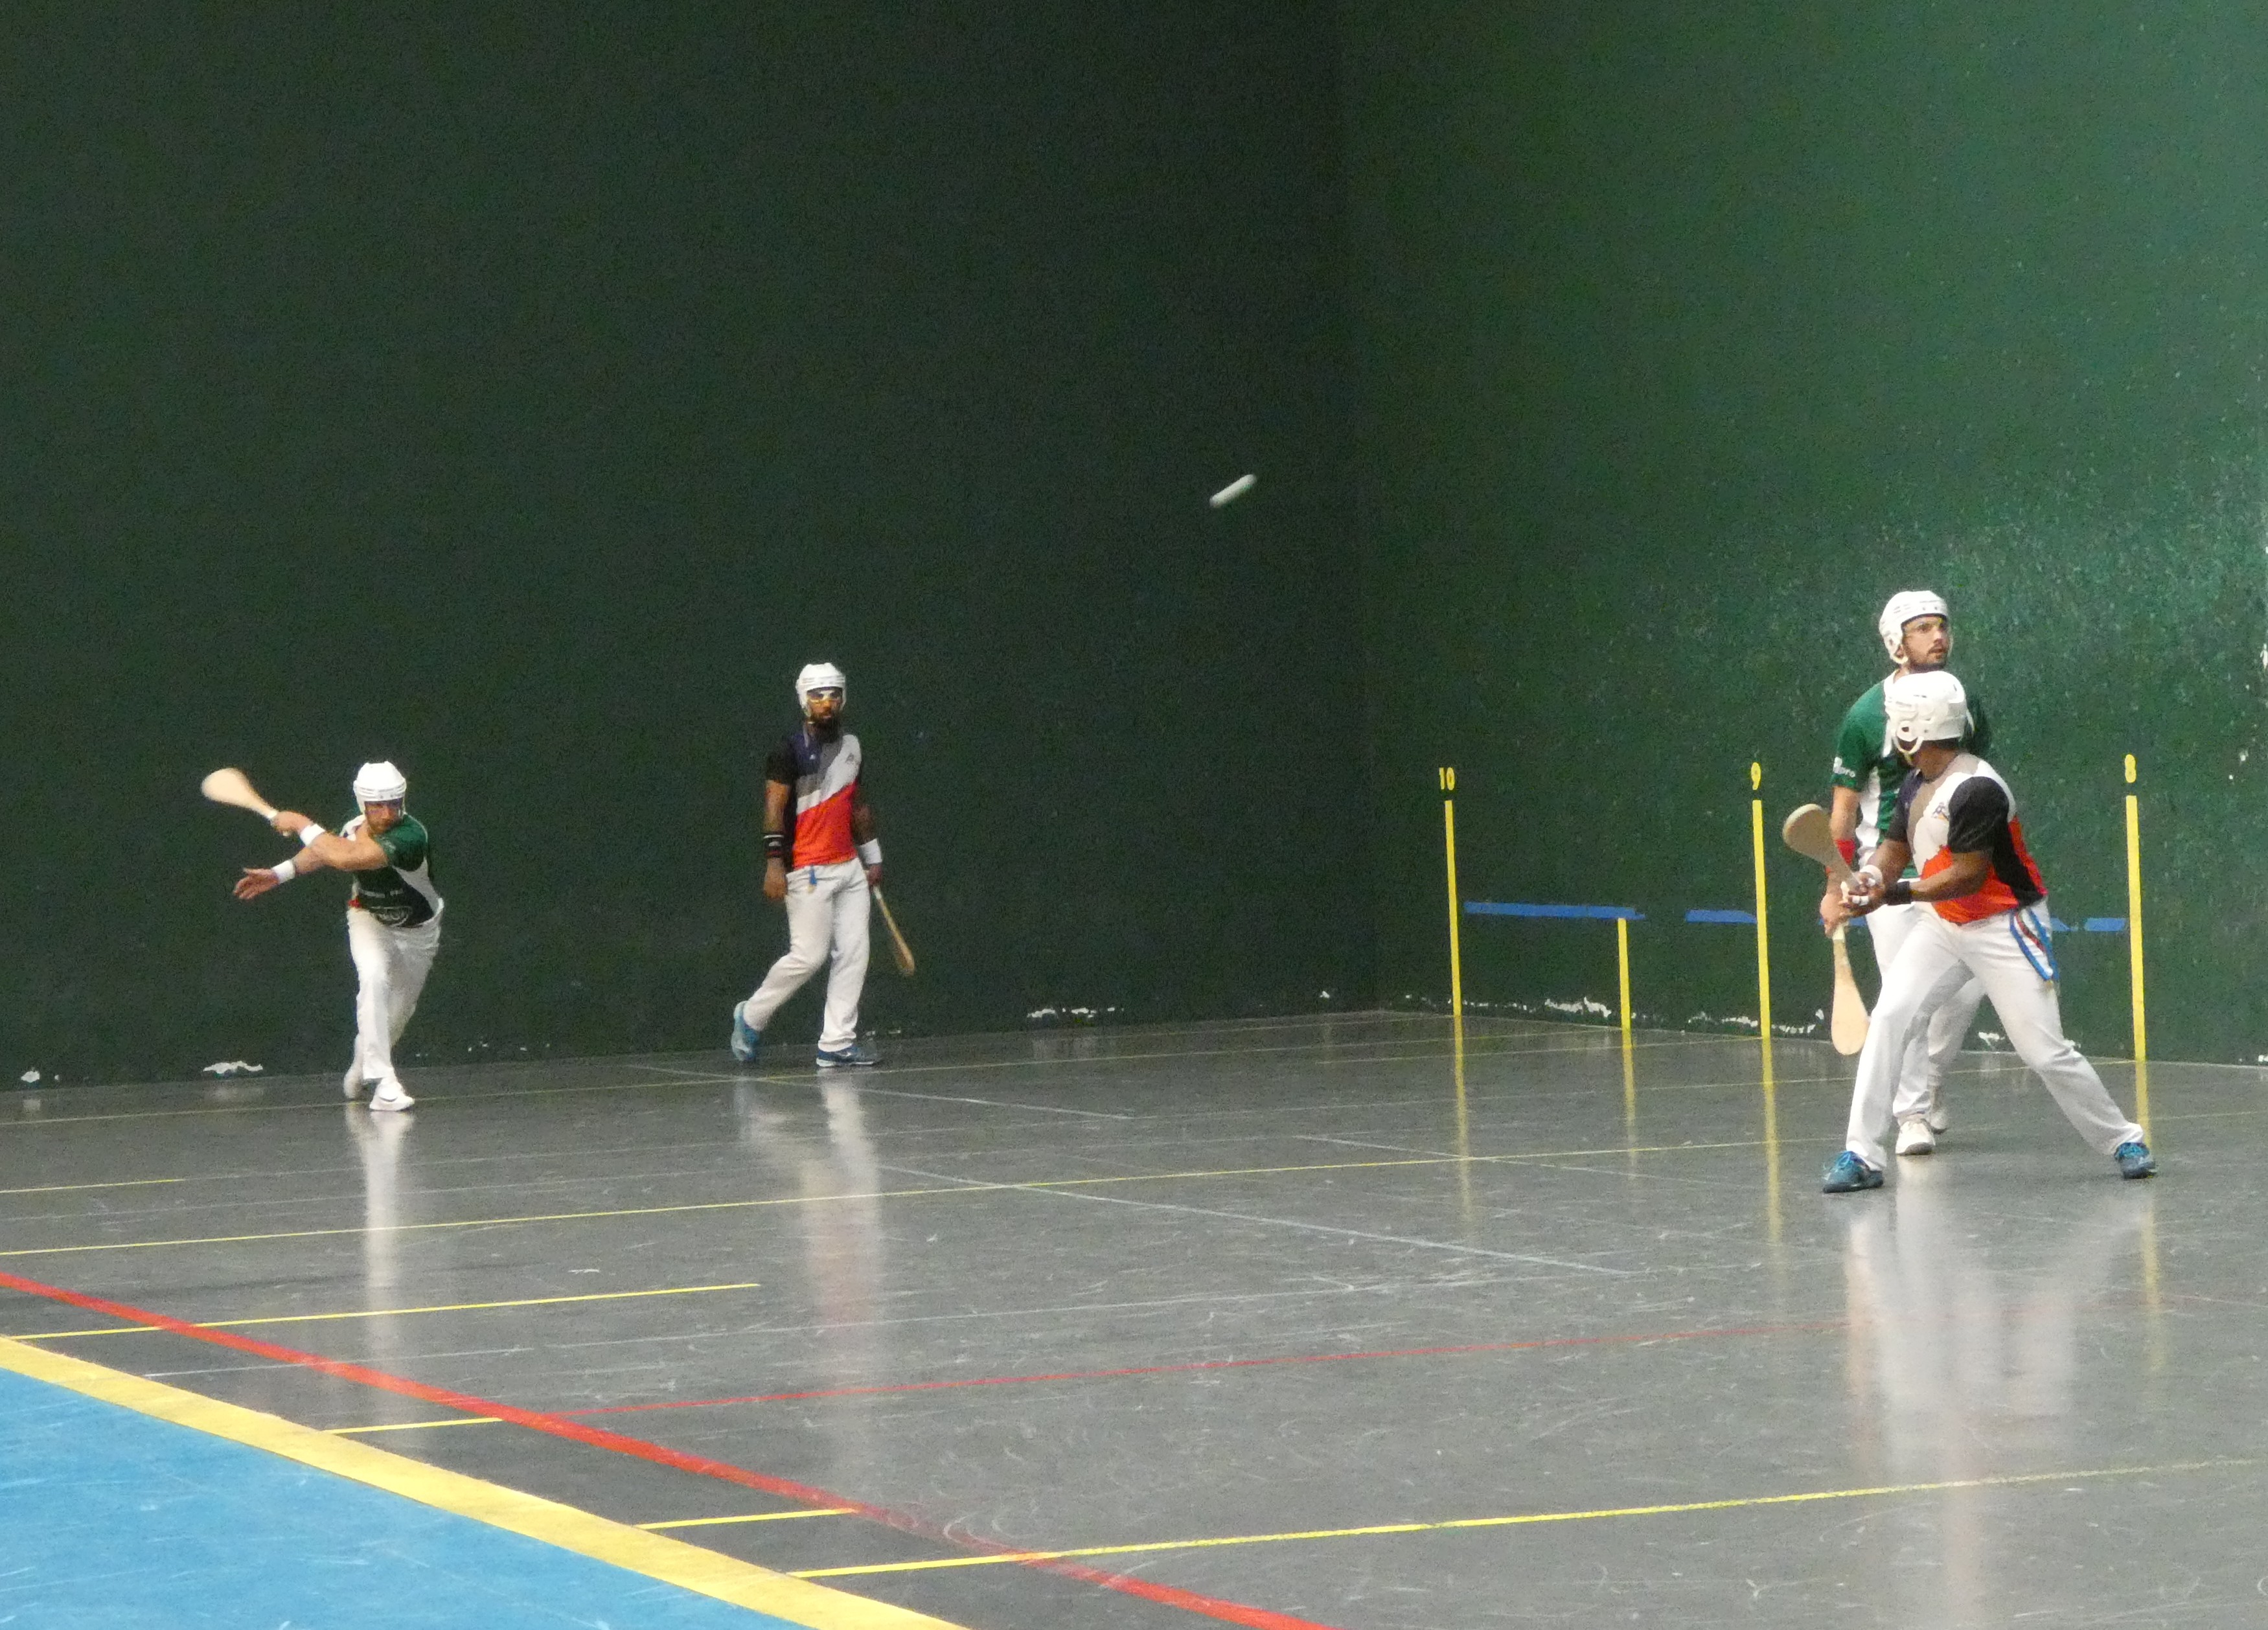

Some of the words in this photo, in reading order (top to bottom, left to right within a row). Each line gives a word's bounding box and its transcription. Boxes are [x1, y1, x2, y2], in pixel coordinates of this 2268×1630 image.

[1439, 767, 1456, 790] 10
[1750, 762, 1761, 790] 9
[2124, 753, 2137, 783] 8
